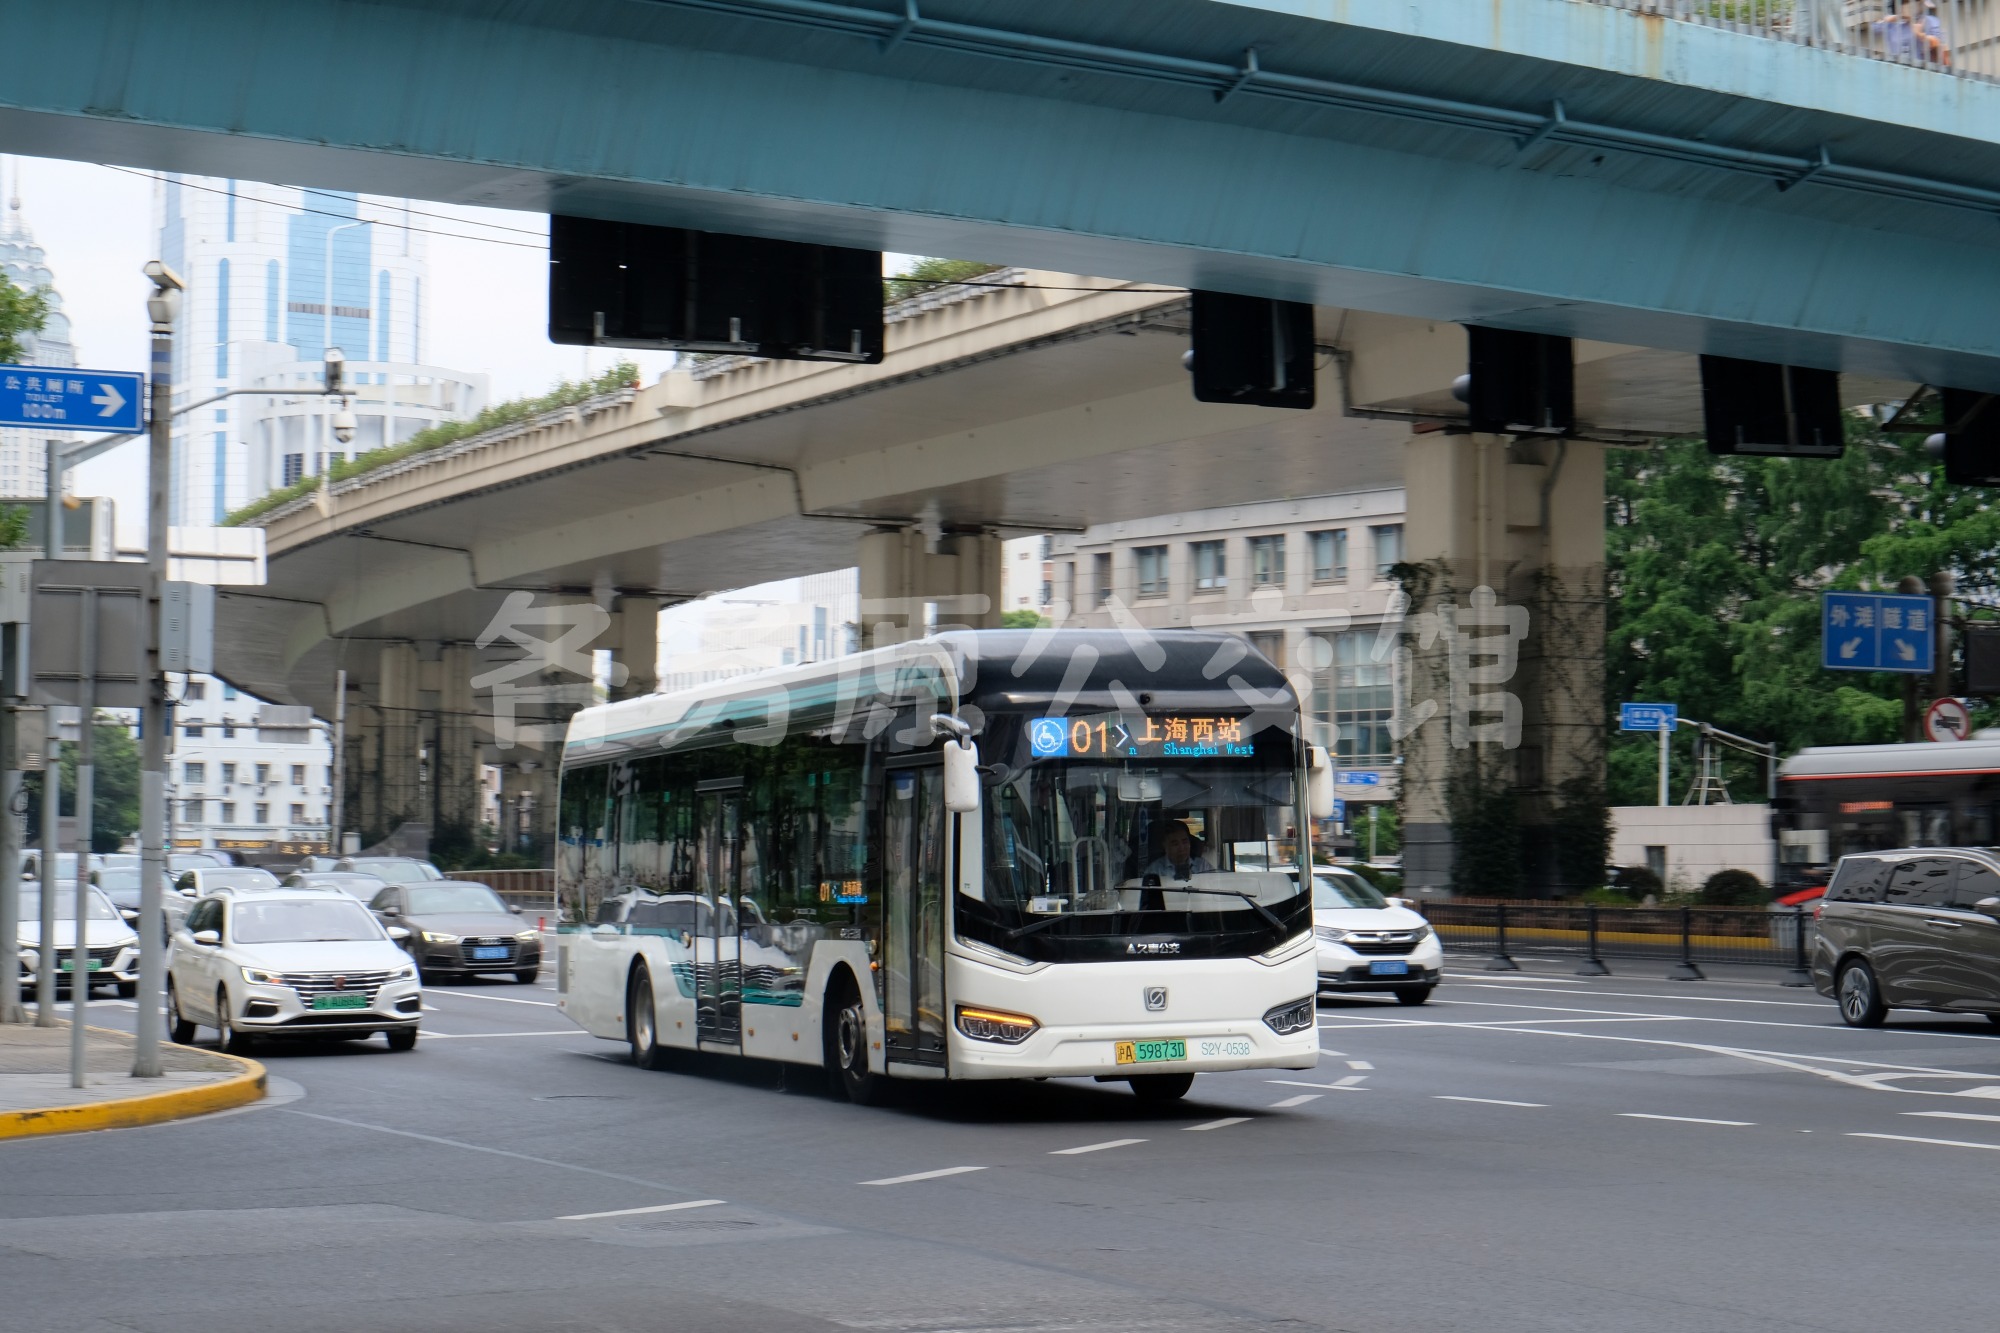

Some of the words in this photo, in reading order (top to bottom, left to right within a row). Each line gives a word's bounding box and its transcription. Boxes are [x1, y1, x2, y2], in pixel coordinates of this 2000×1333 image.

[25, 393, 64, 403] TOILET
[22, 403, 67, 419] 100m
[1071, 720, 1107, 753] 01
[1138, 717, 1241, 743] 上海西站
[1163, 742, 1219, 757] Shanghai
[1226, 743, 1254, 755] West
[1201, 1042, 1251, 1056] S2Y-0538
